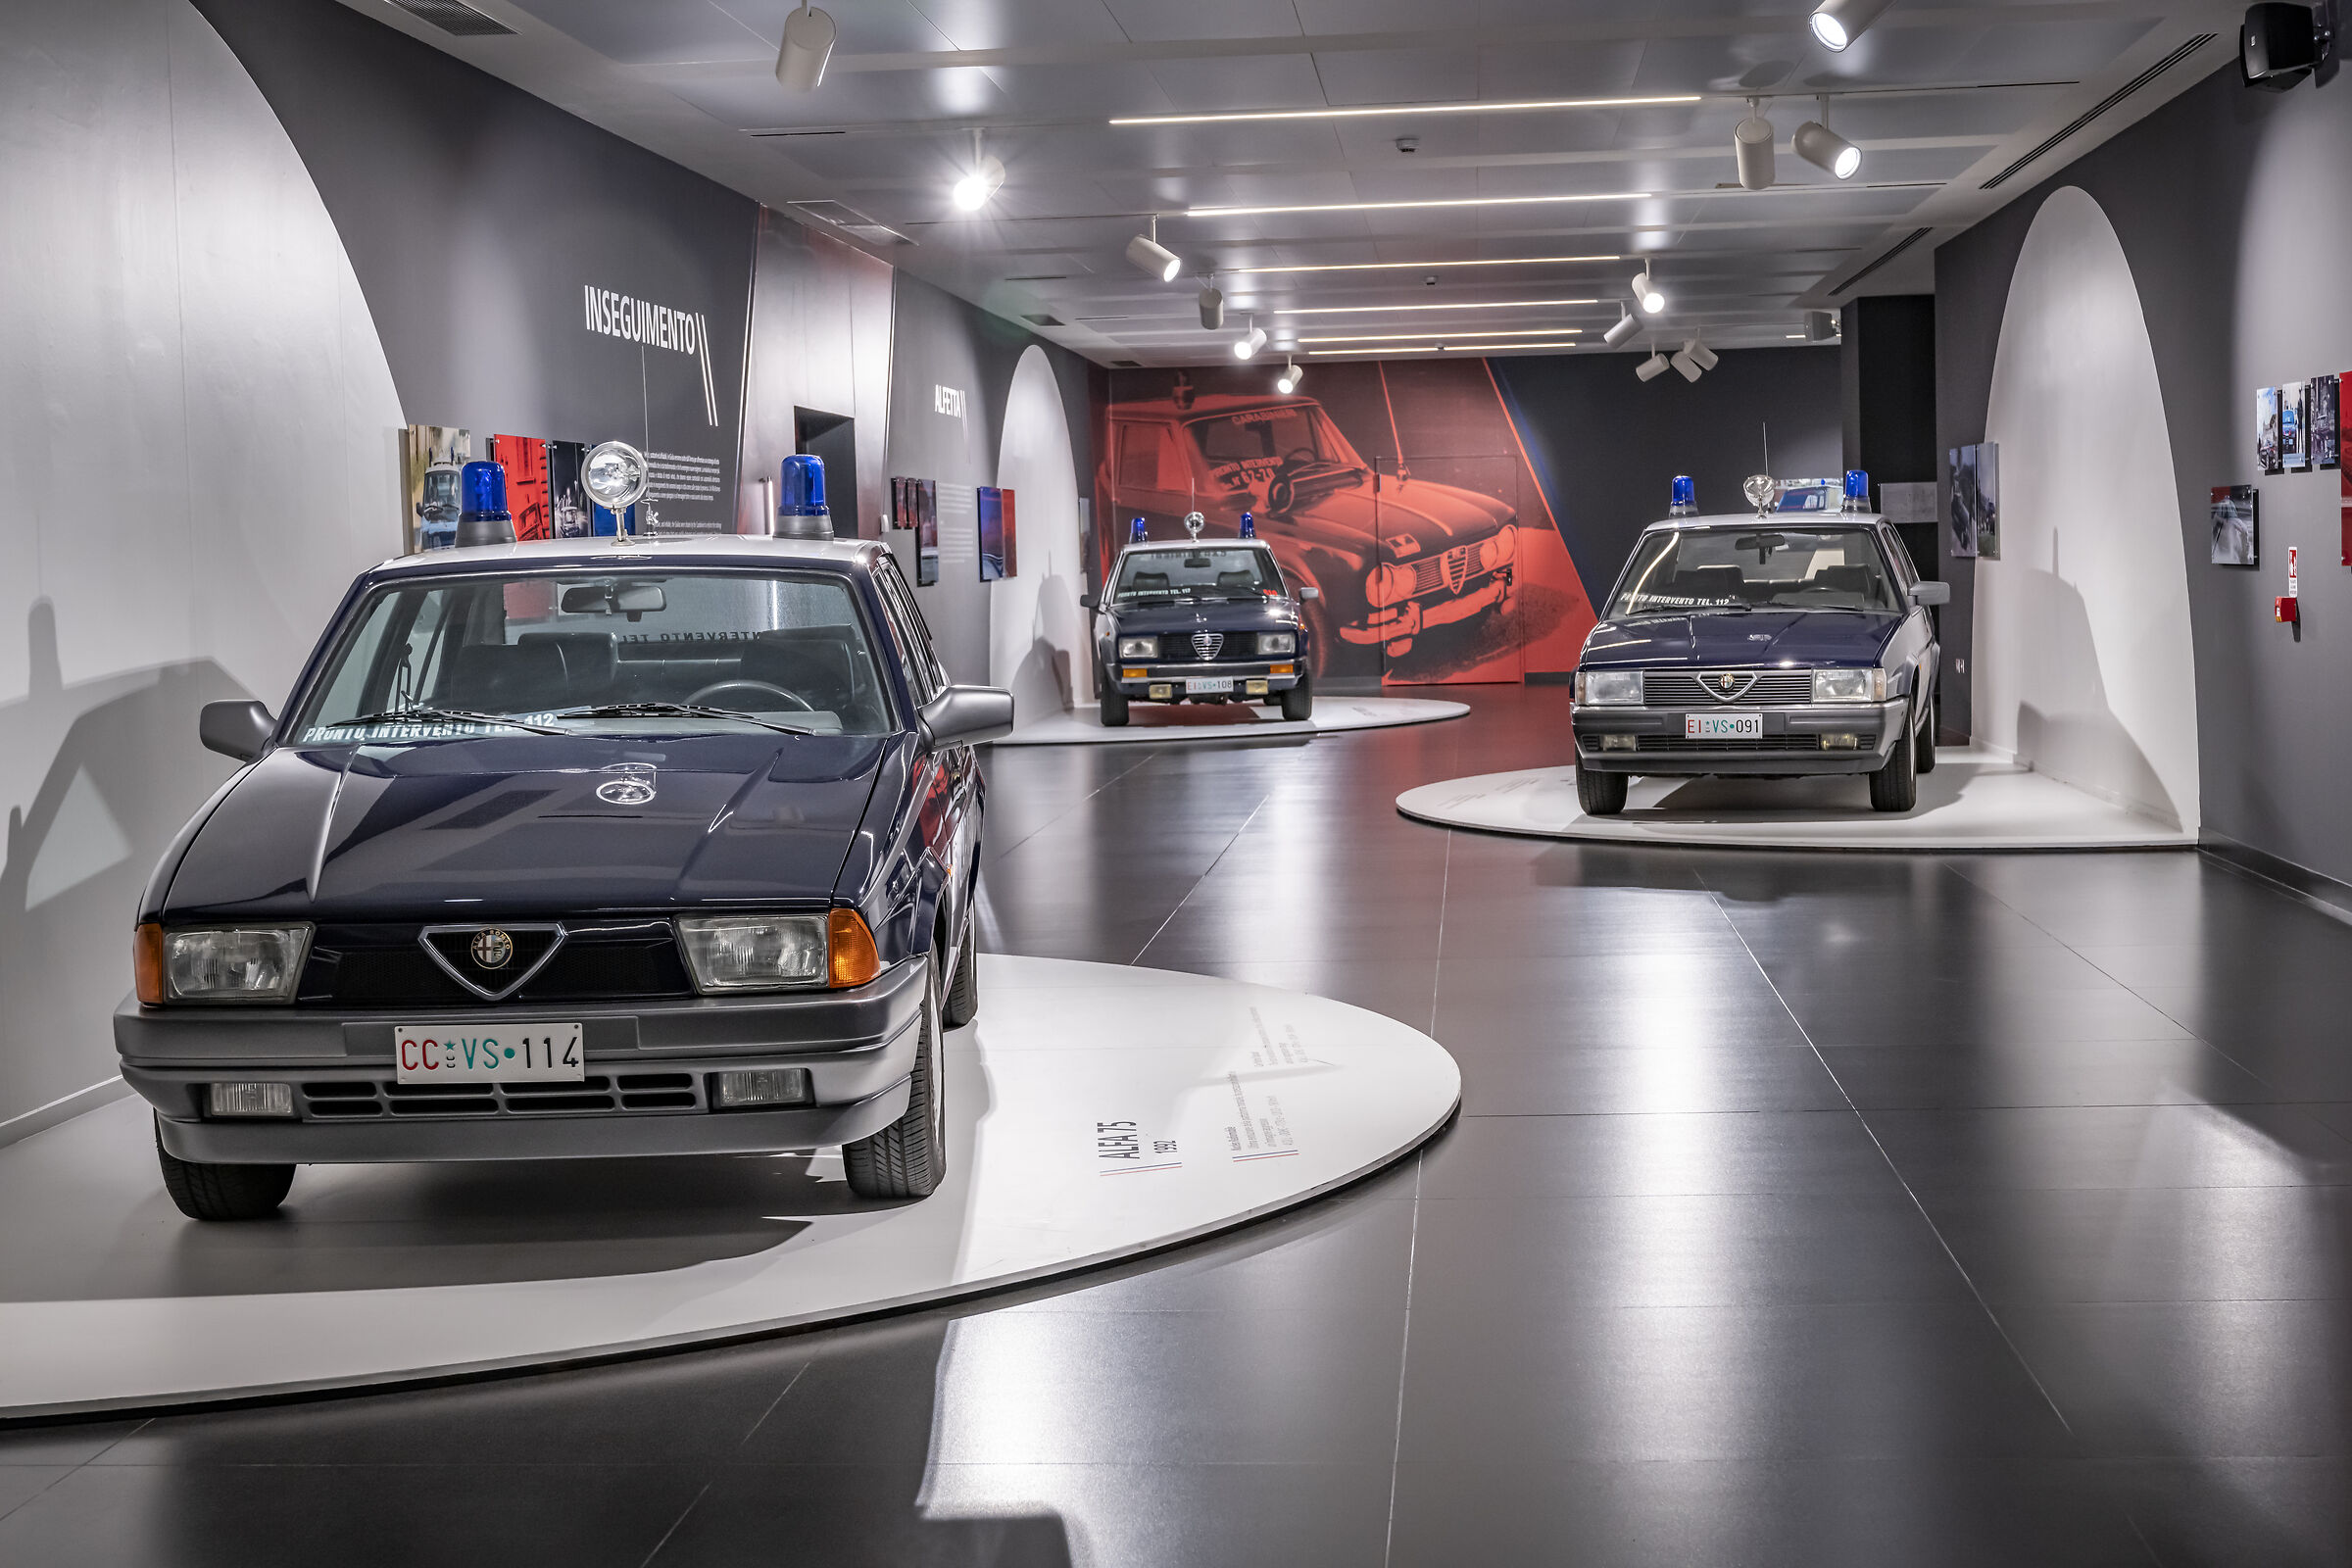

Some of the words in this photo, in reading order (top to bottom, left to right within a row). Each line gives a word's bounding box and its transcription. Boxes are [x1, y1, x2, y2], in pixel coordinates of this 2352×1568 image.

[584, 284, 696, 356] INSEGUIMENTO
[934, 384, 961, 418] ALFETTA
[1648, 594, 1694, 605] INTERVENTO
[523, 712, 555, 727] 112
[1712, 719, 1729, 733] VS
[1736, 718, 1759, 733] 091
[401, 1039, 439, 1071] CC
[461, 1038, 500, 1070] VS
[522, 1036, 579, 1069] 114
[1097, 1120, 1137, 1133] 75
[1097, 1134, 1140, 1159] ALFA
